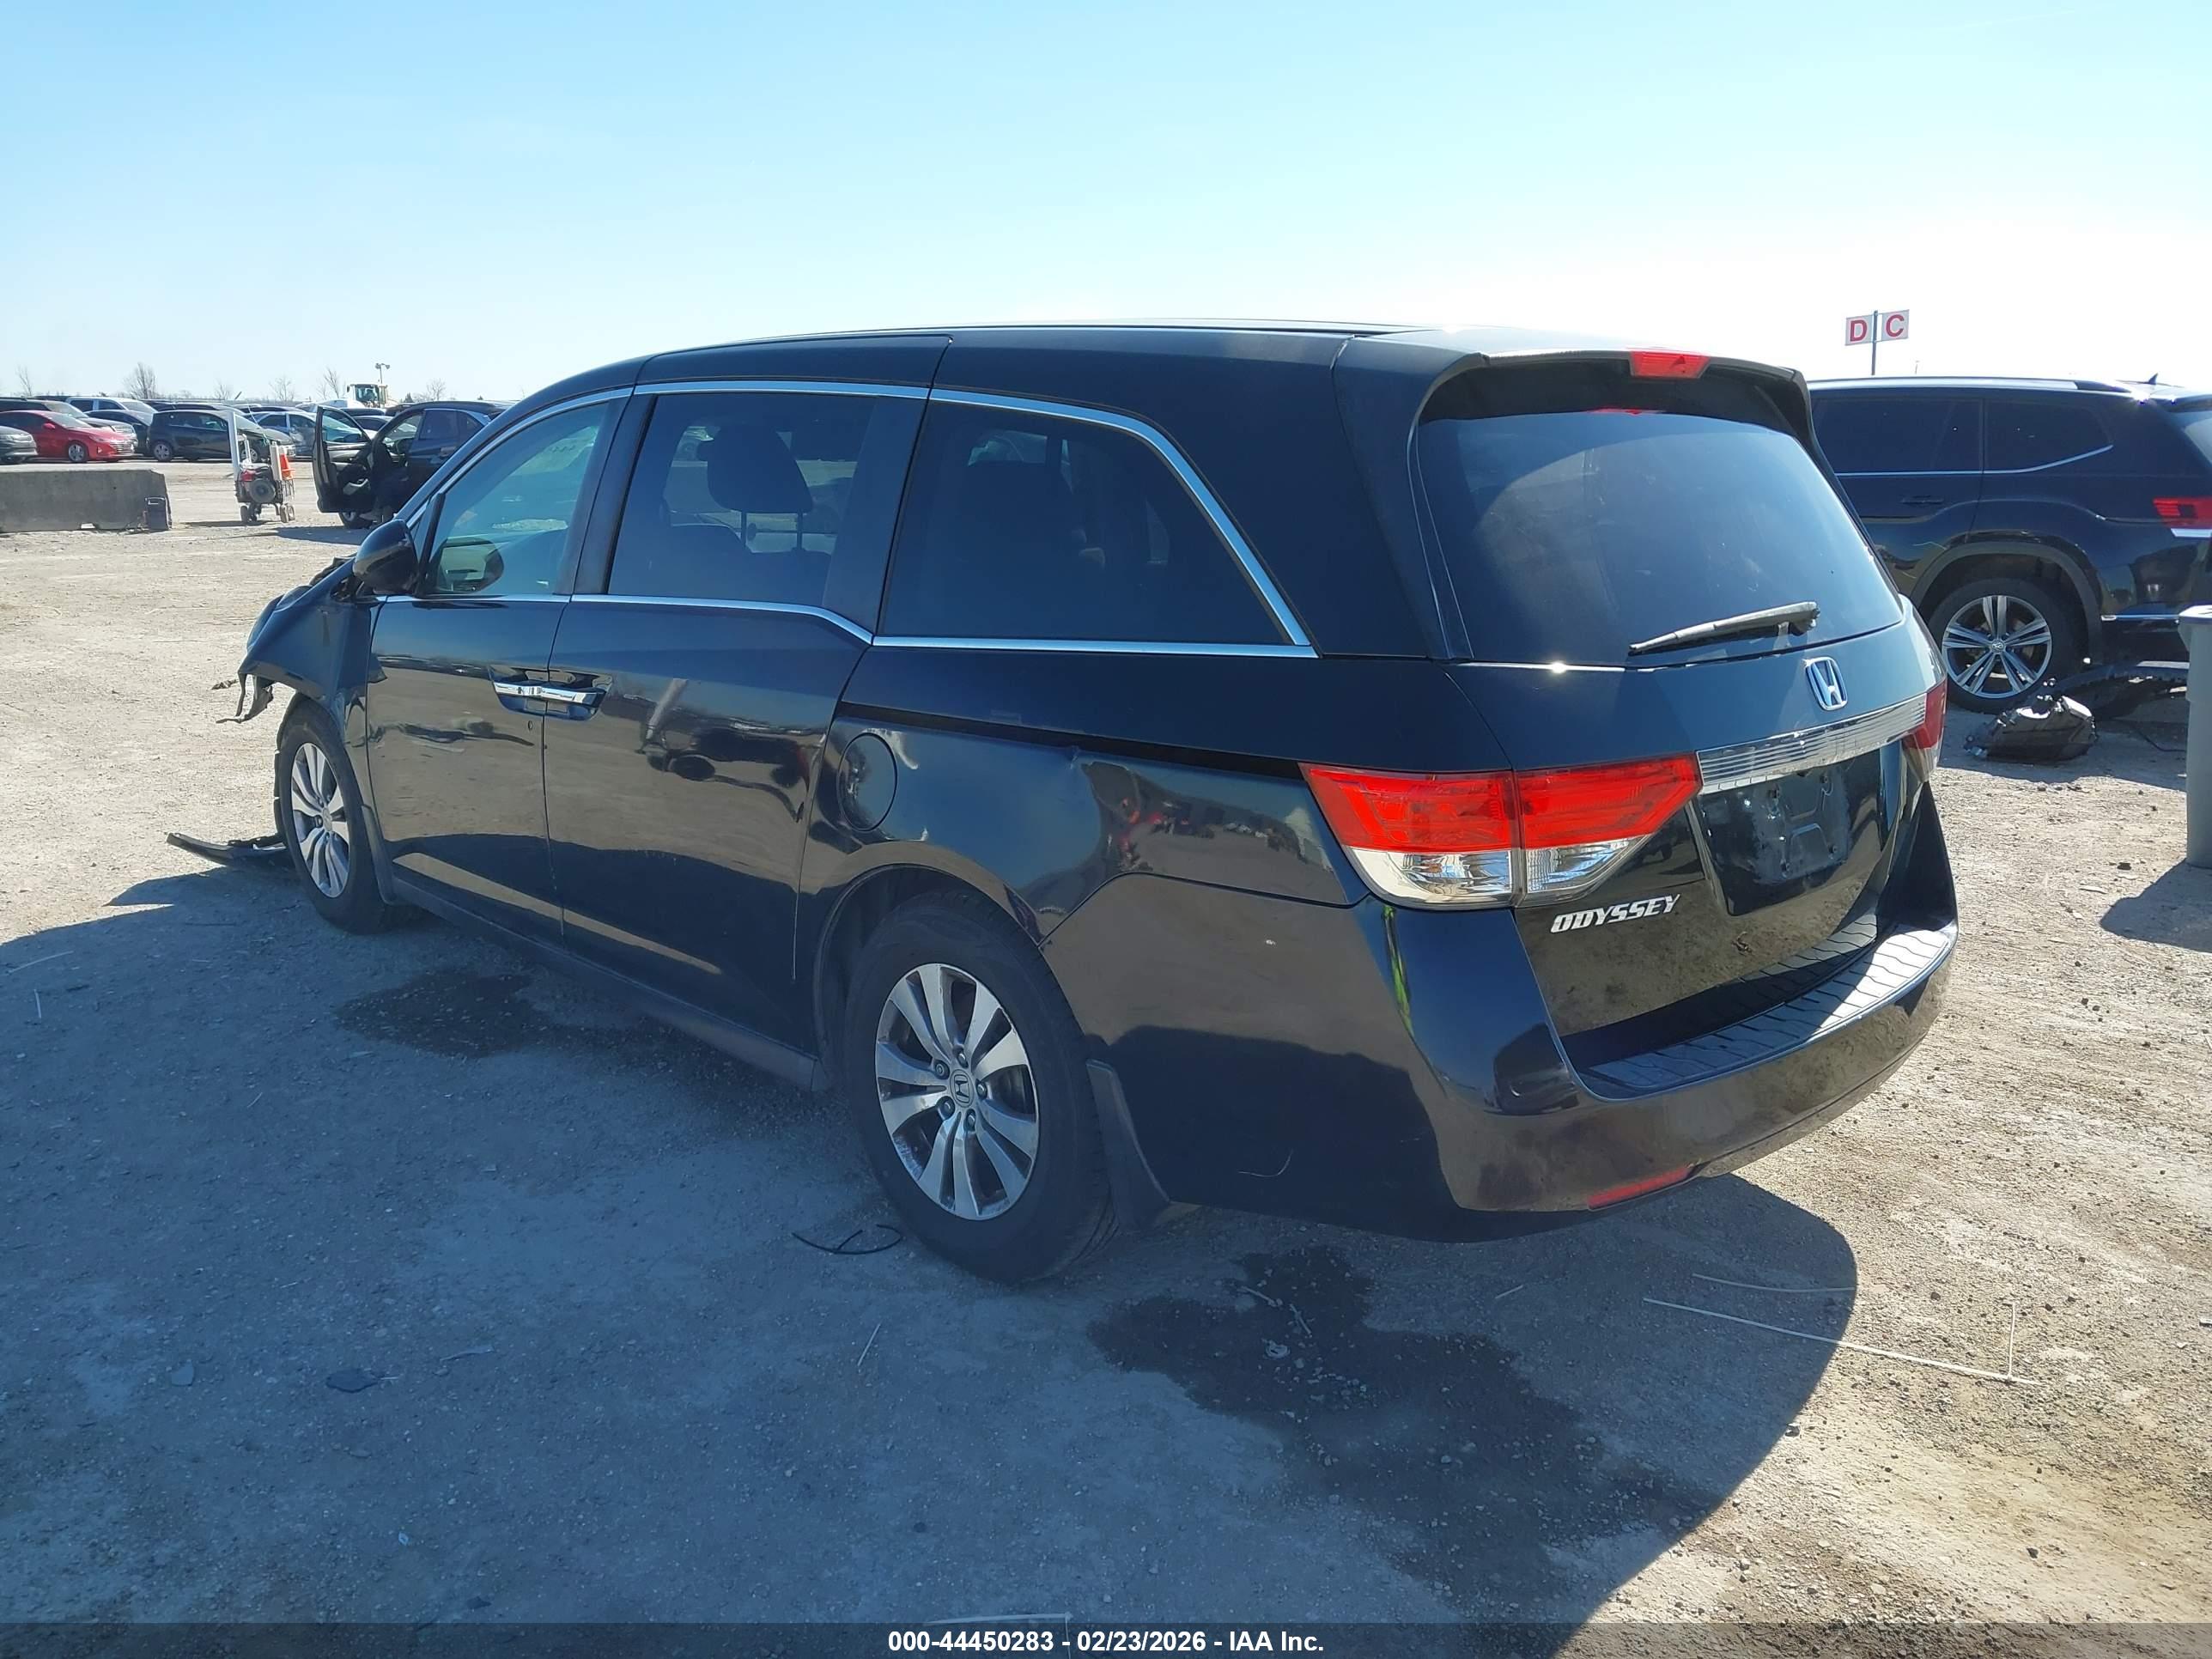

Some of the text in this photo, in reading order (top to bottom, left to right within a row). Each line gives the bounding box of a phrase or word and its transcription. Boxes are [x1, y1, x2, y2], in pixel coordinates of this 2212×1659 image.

[1850, 319, 1868, 342] D
[1886, 314, 1905, 337] C
[1550, 894, 1681, 933] ODYSSEY
